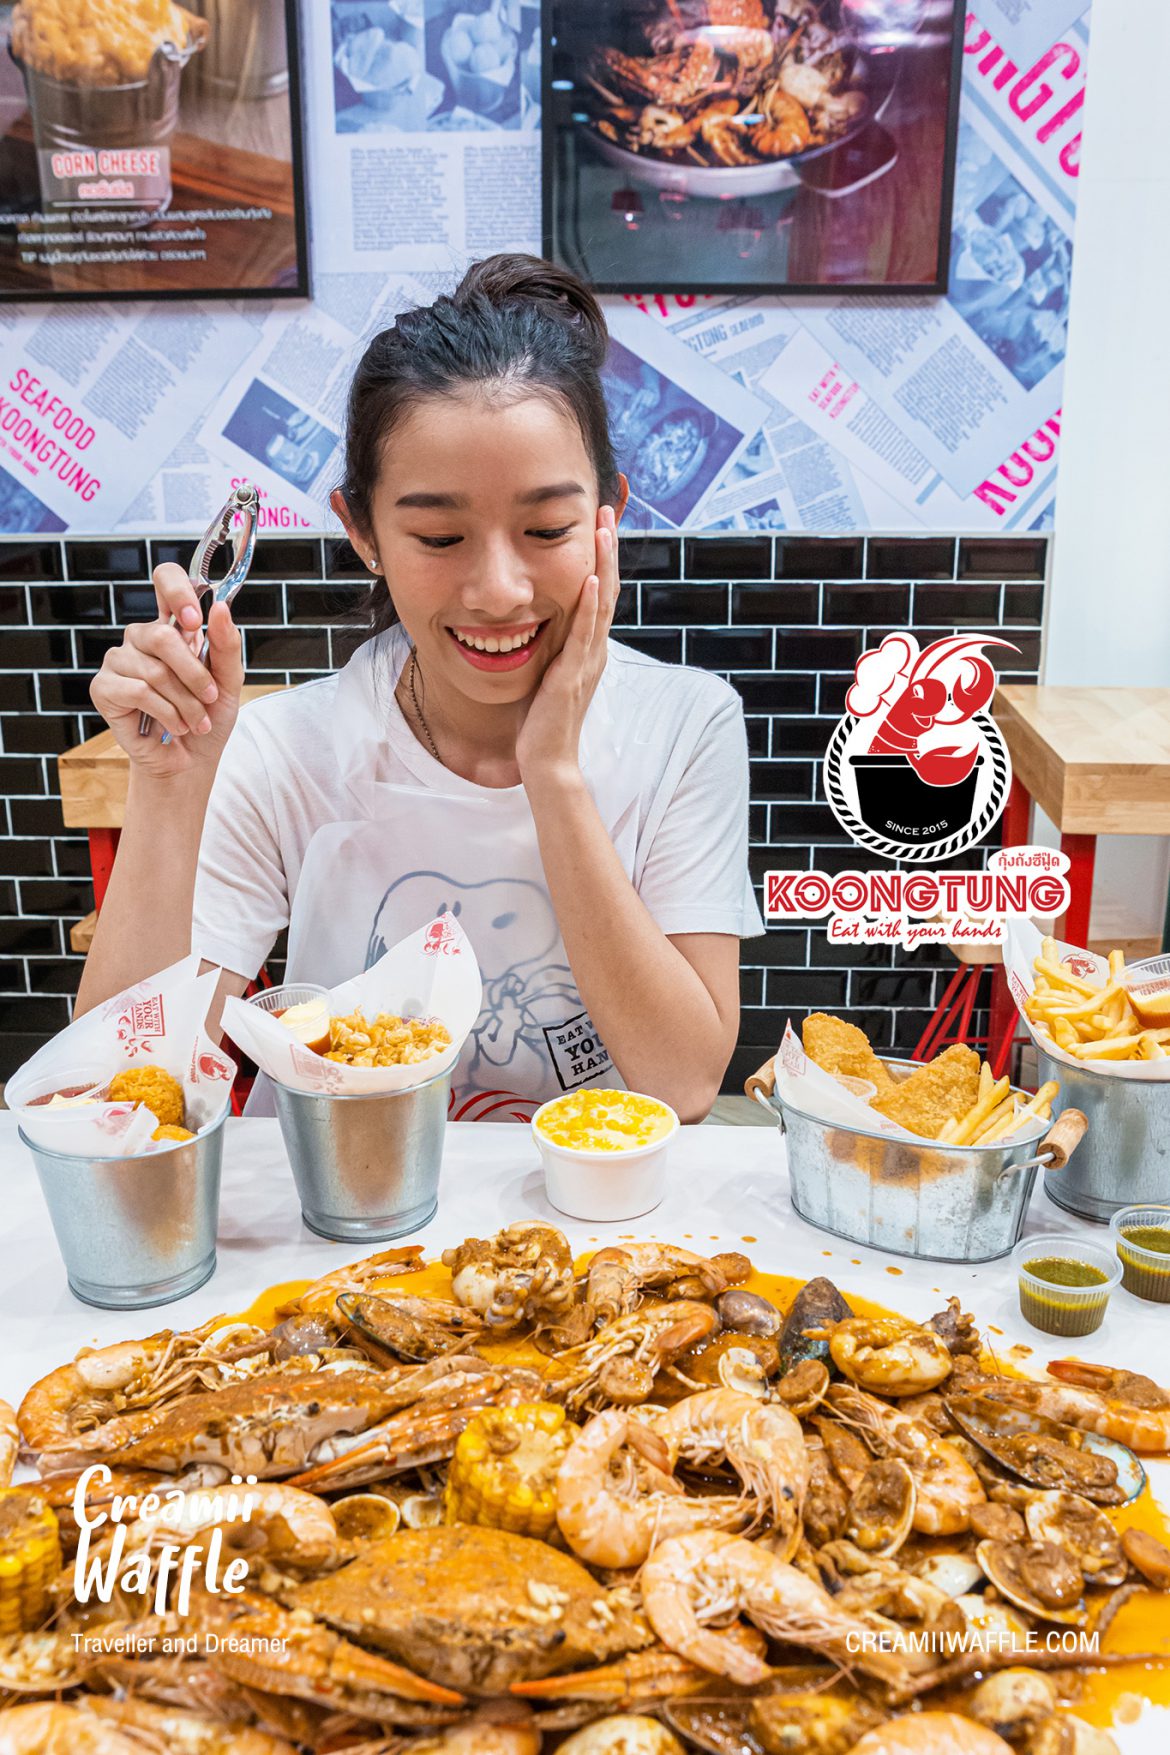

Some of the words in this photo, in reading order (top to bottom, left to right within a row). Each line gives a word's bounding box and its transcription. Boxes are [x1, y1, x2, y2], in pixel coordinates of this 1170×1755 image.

[52, 151, 98, 178] CORN
[100, 150, 160, 177] CHEESE
[9, 368, 96, 451] SEAFOOD
[556, 1025, 583, 1045] EAT
